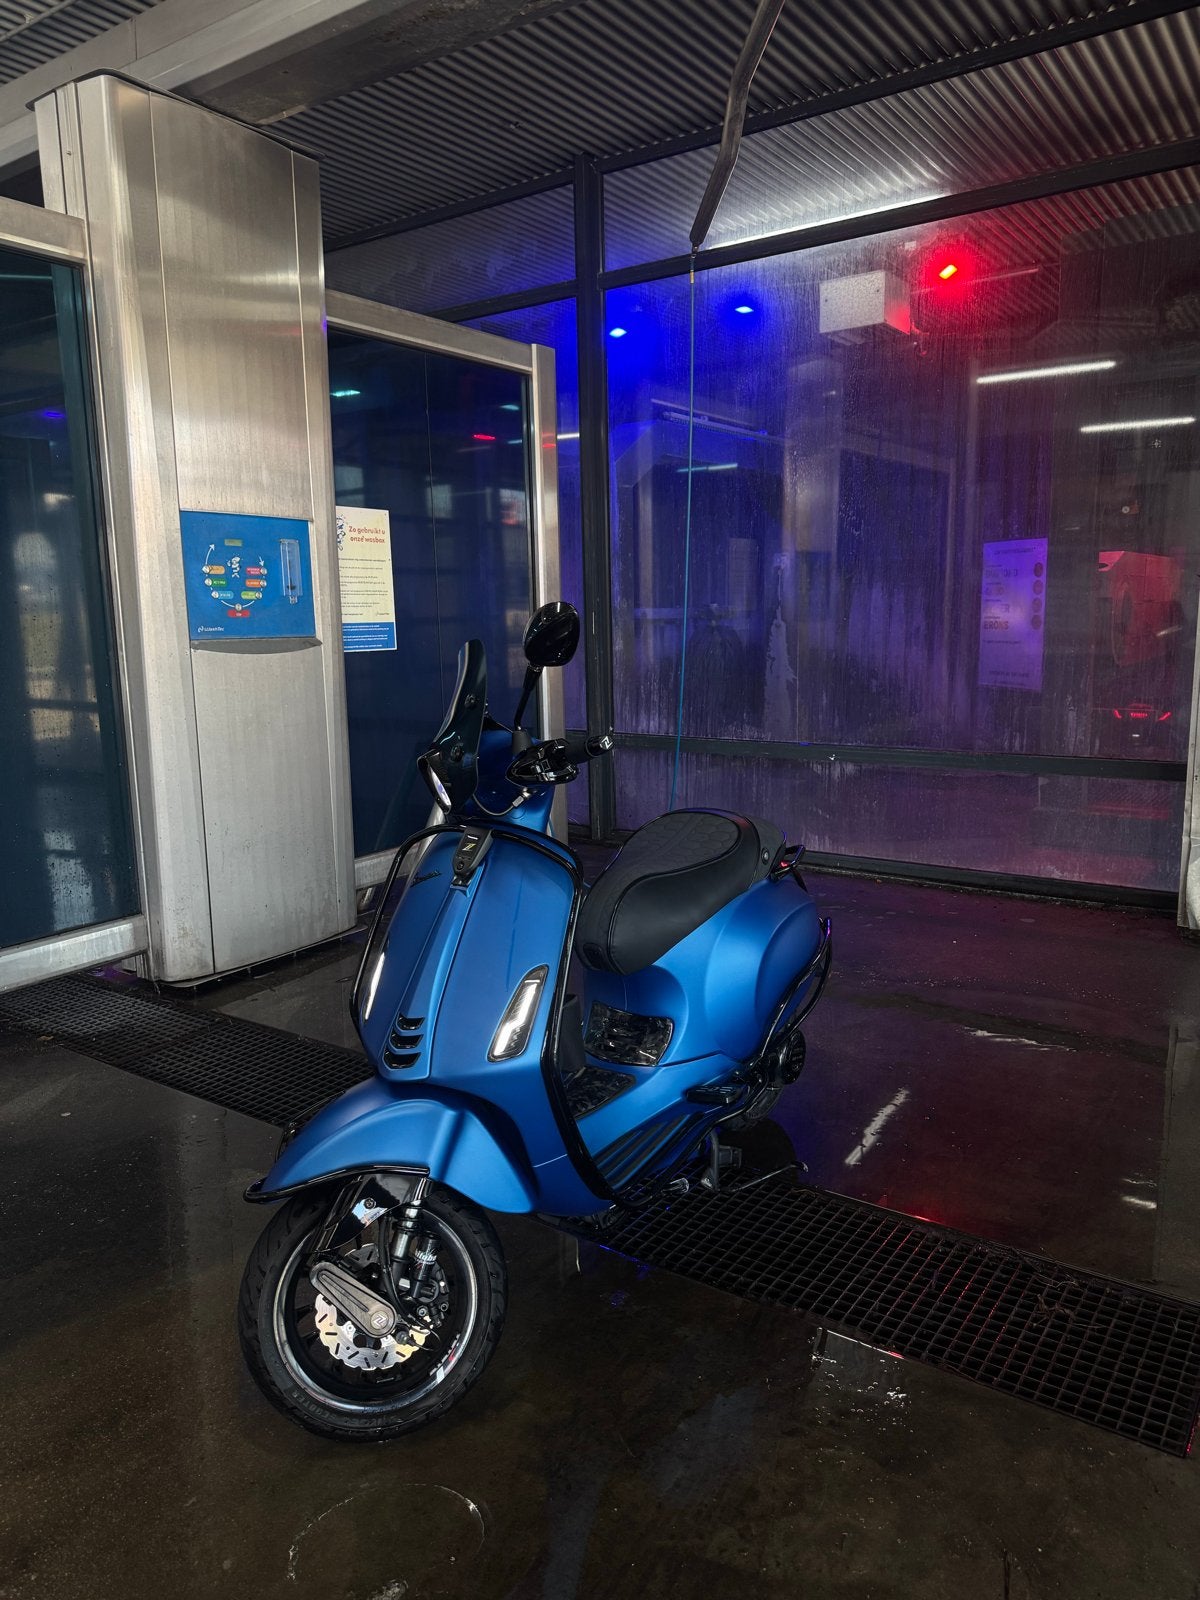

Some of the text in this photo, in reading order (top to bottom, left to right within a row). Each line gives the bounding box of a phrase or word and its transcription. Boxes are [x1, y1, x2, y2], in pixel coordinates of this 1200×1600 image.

[348, 525, 357, 533] Zo
[357, 526, 381, 535] gebruikt
[364, 536, 385, 544] wasbox
